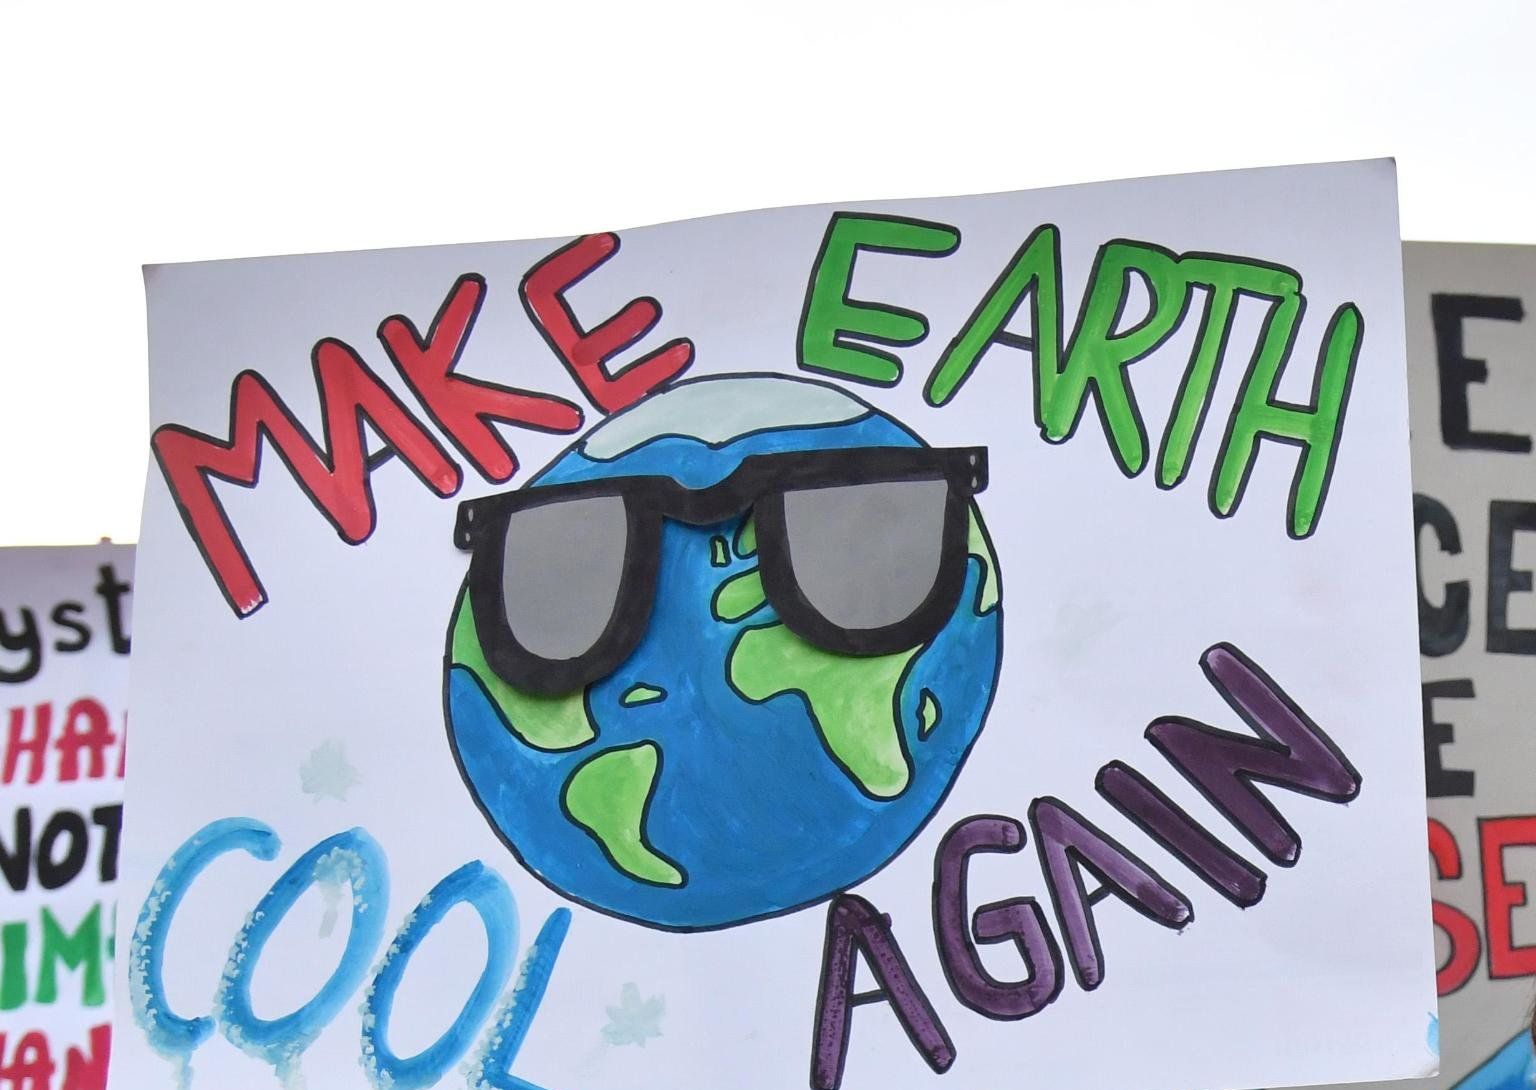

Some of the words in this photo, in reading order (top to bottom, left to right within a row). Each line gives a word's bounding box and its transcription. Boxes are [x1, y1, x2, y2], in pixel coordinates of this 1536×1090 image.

[151, 231, 695, 619] MAKE
[797, 211, 1365, 540] EARTH
[2, 697, 127, 785] HA
[0, 900, 117, 1010] IM
